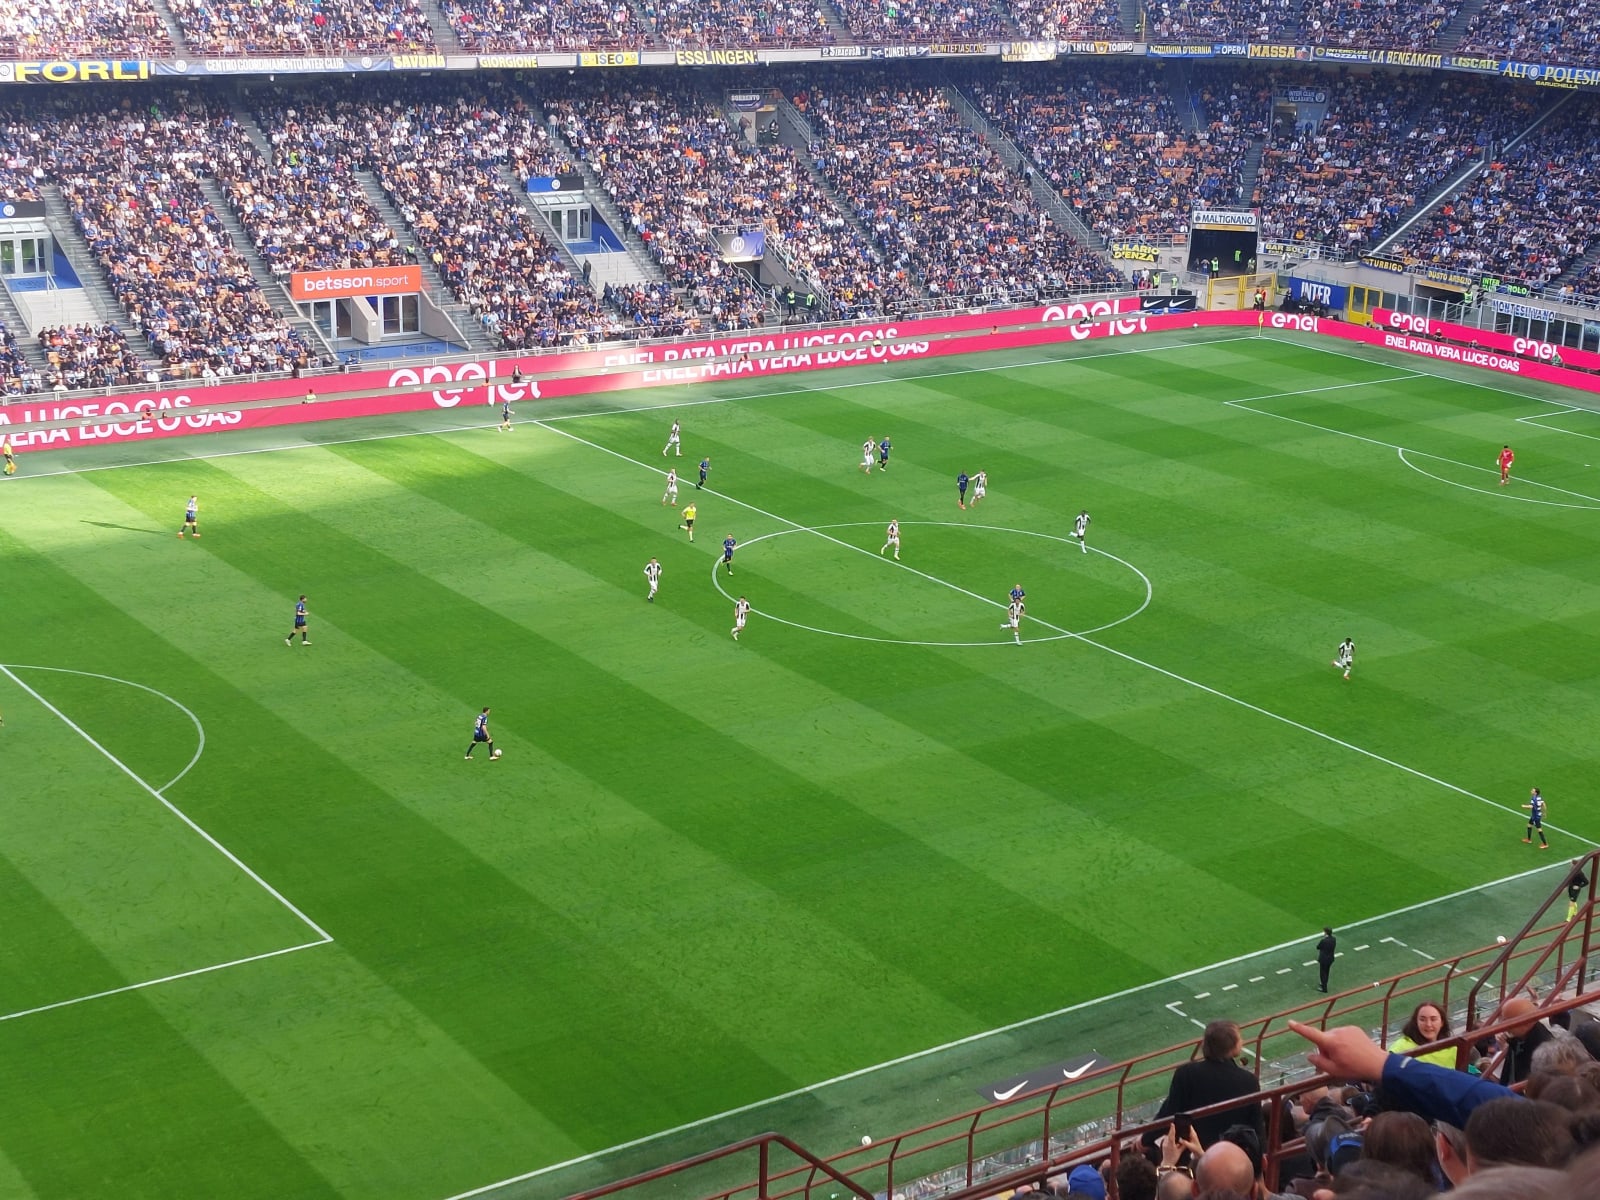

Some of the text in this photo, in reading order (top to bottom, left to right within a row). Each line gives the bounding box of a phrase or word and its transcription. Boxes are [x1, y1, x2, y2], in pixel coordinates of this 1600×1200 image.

[931, 44, 986, 54] MONTEFIASCONE
[1109, 42, 1133, 52] TORINO
[1149, 45, 1182, 55] ACQUAVIVA
[1222, 45, 1246, 55] OPERA
[1250, 45, 1295, 58] MASSA
[392, 55, 445, 68] SAVONA
[595, 54, 624, 65] ISEO
[1326, 51, 1368, 60] MOZZATE
[1386, 50, 1442, 68] BENEAMATA
[206, 57, 344, 72] CENTRO COORDINAMENTO INTER CLUB
[480, 56, 537, 68] GIORGIONE
[1452, 57, 1499, 71] LISCATE
[1536, 80, 1578, 89] BARUCHELLA
[1202, 213, 1253, 225] MALTIGNANO
[1113, 243, 1160, 255] S.ILARIO
[1265, 243, 1283, 251] BAR
[1114, 251, 1154, 262] D'ENZA
[1368, 258, 1403, 272] TURBIGO
[304, 274, 408, 292] betsson.sport
[1482, 277, 1500, 287] INTER
[1301, 281, 1331, 305] INTER
[1492, 300, 1555, 323] MONTESILVANO
[1271, 312, 1318, 332] enel
[1389, 312, 1429, 334] enel
[1385, 334, 1520, 372] ENEL RATA VERA LUCE O GAS
[1513, 338, 1557, 360] enel
